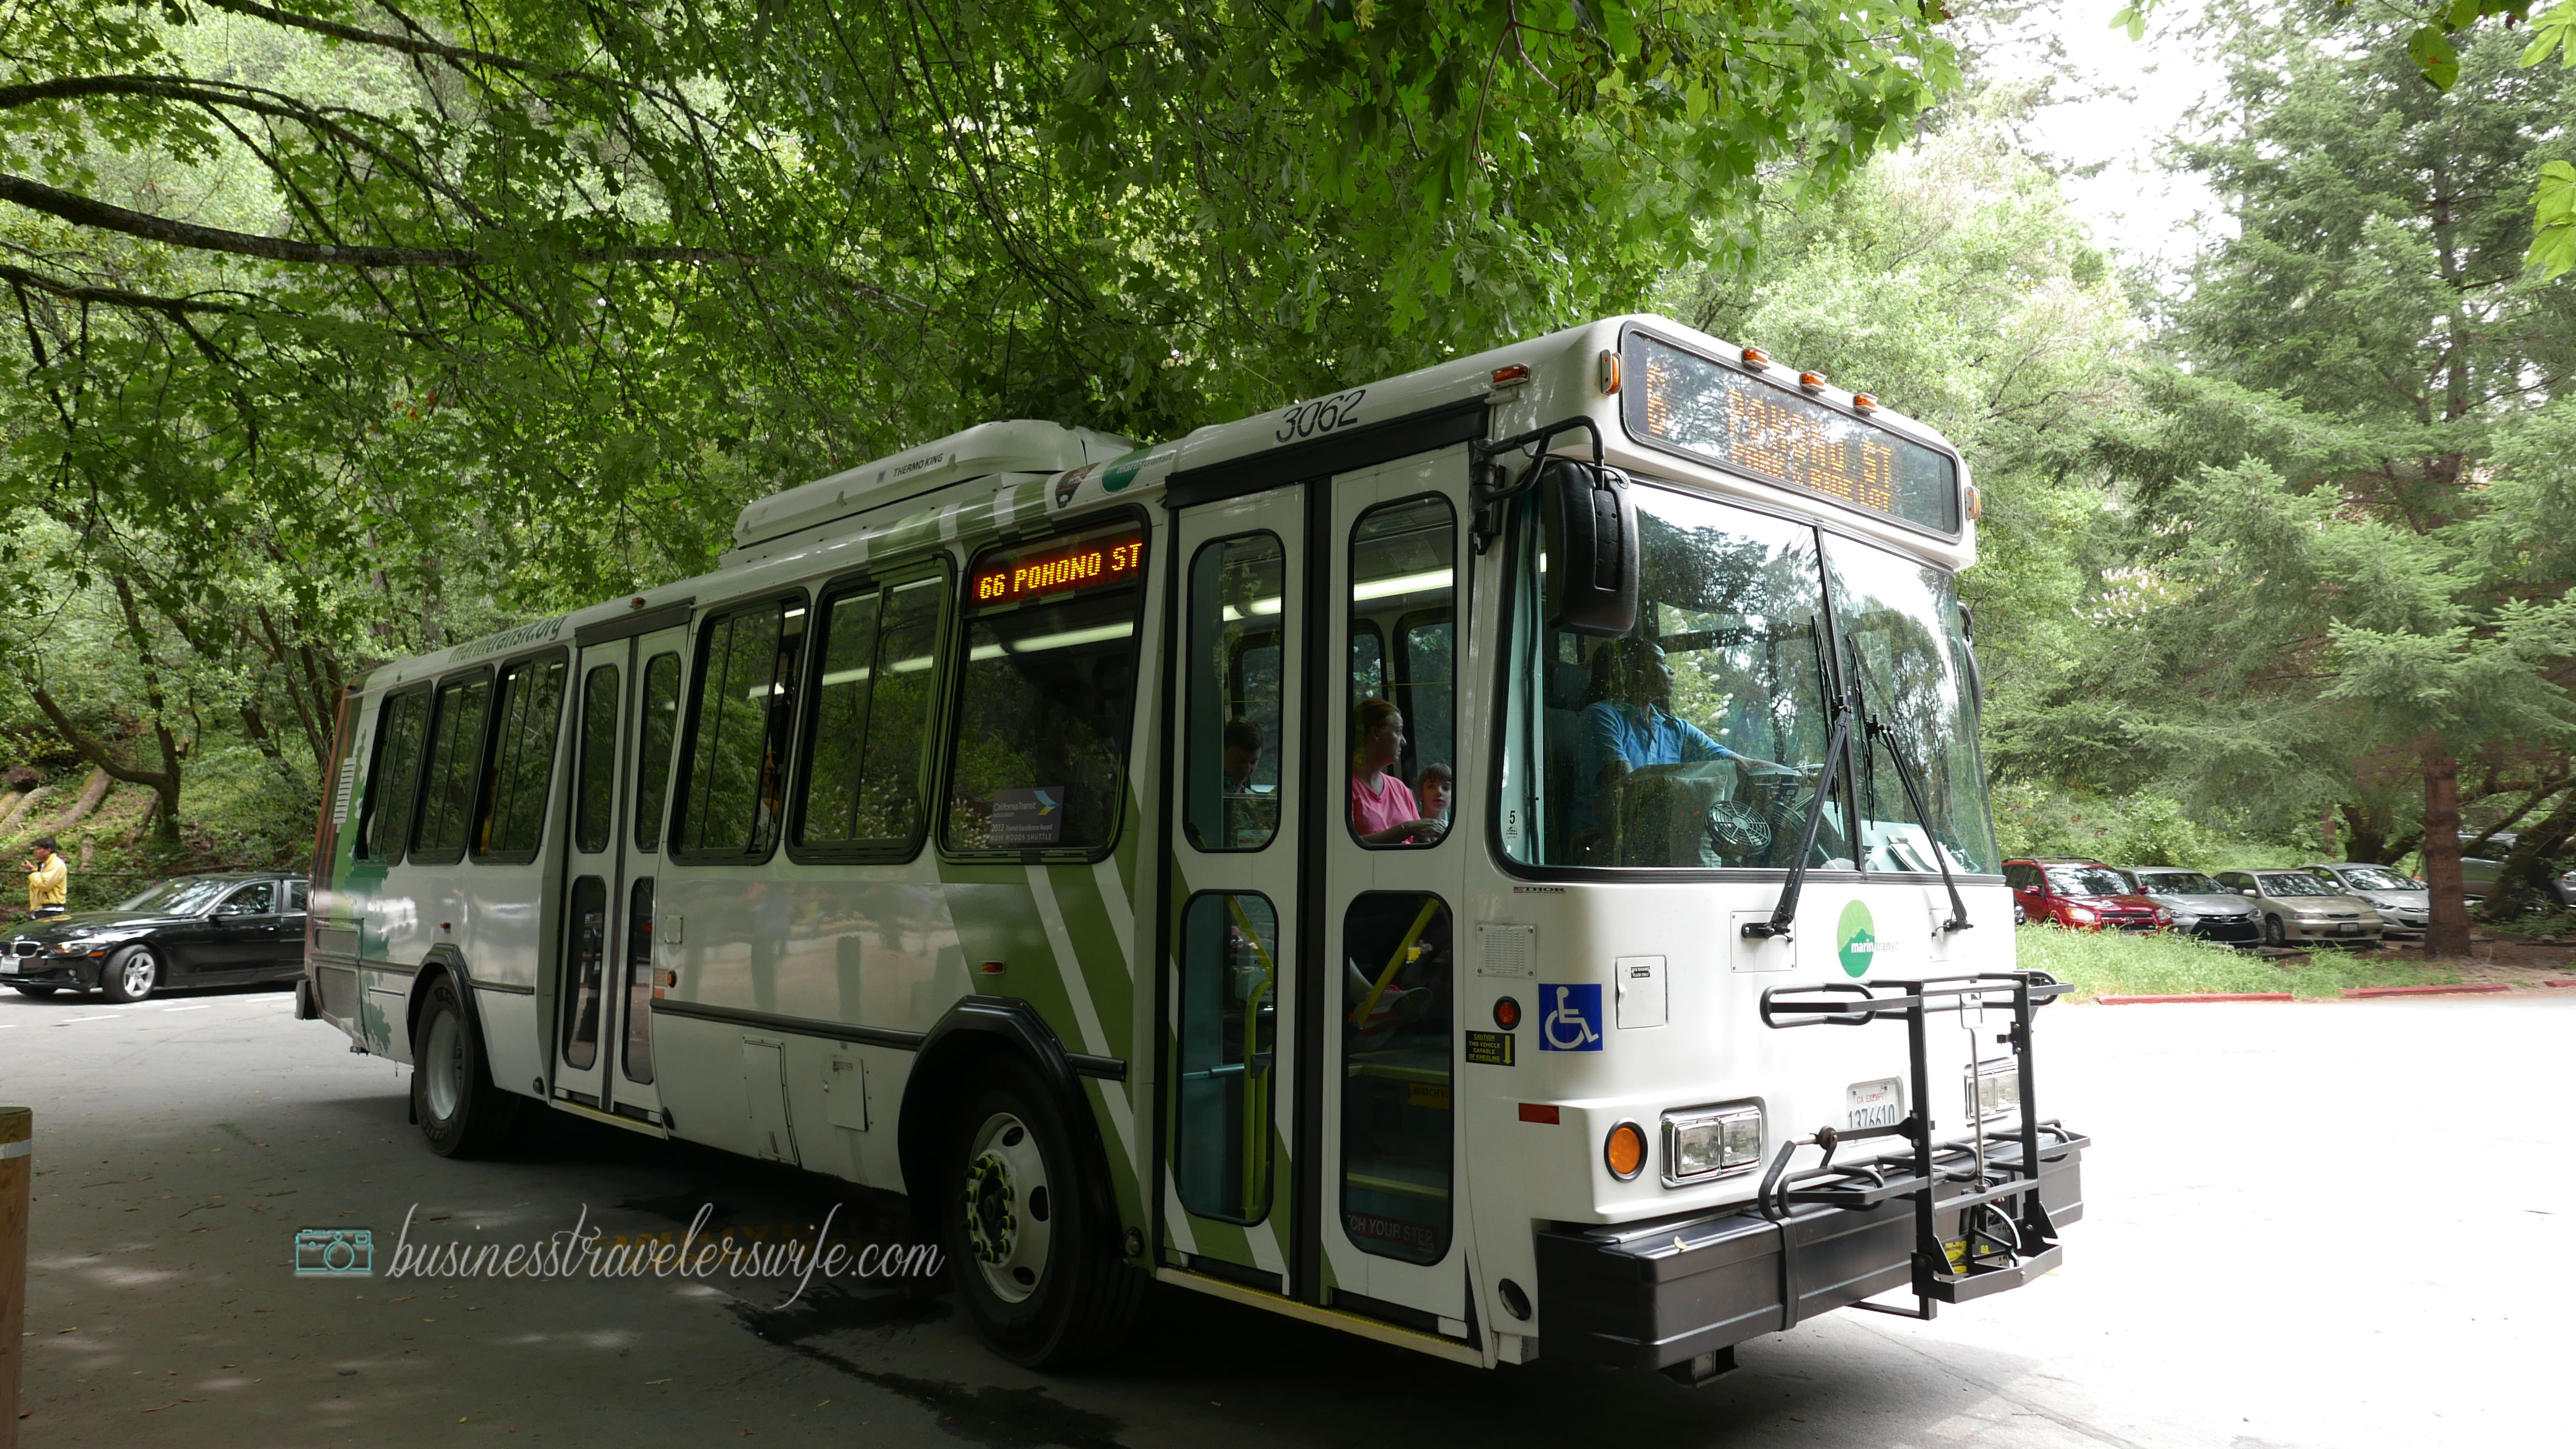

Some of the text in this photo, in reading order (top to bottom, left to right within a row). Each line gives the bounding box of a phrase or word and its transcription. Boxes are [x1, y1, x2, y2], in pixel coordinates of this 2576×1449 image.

[1276, 389, 1366, 443] 3062
[1727, 389, 1892, 488] POHONO ST
[894, 459, 925, 477] THERMO
[925, 453, 944, 467] KING
[1860, 484, 1891, 512] LOT
[979, 542, 1143, 599] 66 POHONO ST
[991, 823, 1004, 832] 2012
[1509, 810, 1516, 824] 5
[1027, 833, 1052, 841] SHUTTLE
[1850, 938, 1874, 953] marin
[1857, 1092, 1885, 1104] CA EXEMPT
[1849, 1103, 1895, 1129] 1376610
[1368, 1218, 1401, 1239] YOUR
[1403, 1225, 1433, 1243] STEP
